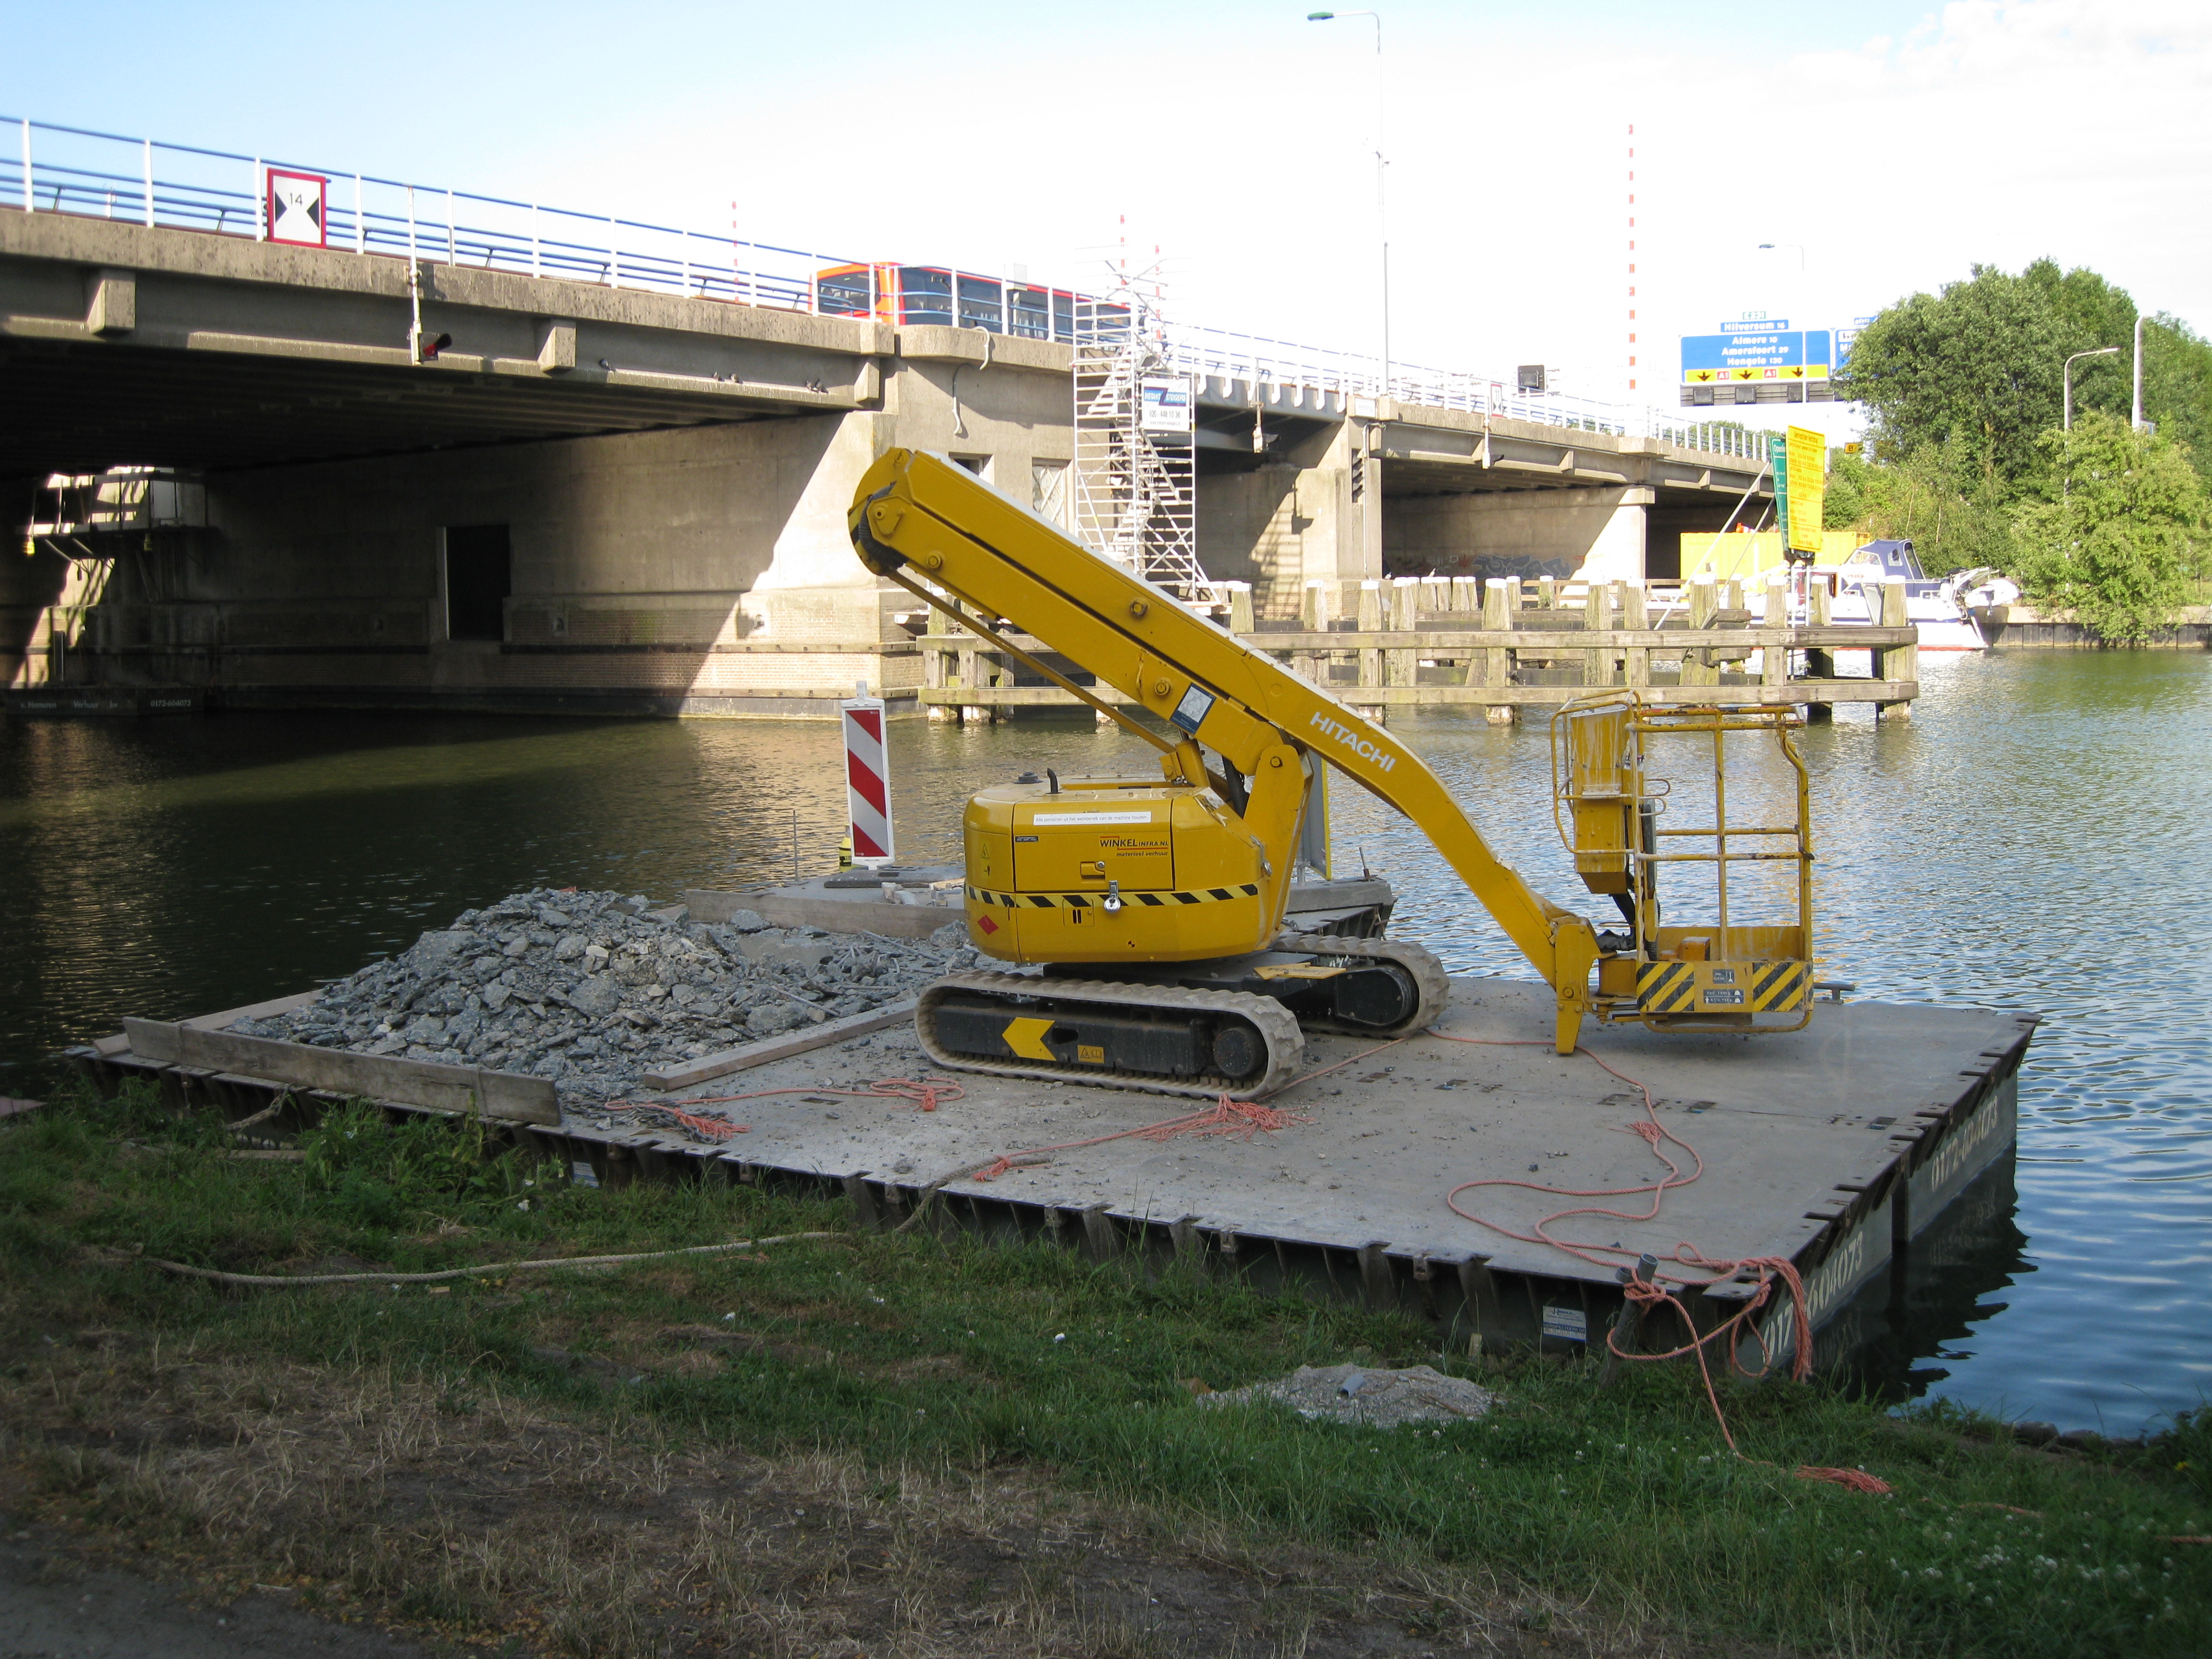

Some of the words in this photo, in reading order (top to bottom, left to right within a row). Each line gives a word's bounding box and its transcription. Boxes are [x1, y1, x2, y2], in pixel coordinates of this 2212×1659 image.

[289, 192, 303, 206] 14
[1724, 322, 1775, 332] Hilversum
[1731, 336, 1767, 345] Almere
[1721, 346, 1776, 356] Amersfoort
[1726, 357, 1766, 367] Hengelo
[1718, 372, 1729, 380] A1
[1765, 369, 1776, 378] A1
[73, 700, 100, 708] Verhuur
[109, 700, 119, 708] bv
[150, 699, 191, 707] 0172-604073
[1310, 711, 1396, 772] HITACHI
[1099, 839, 1138, 848] WINKEL
